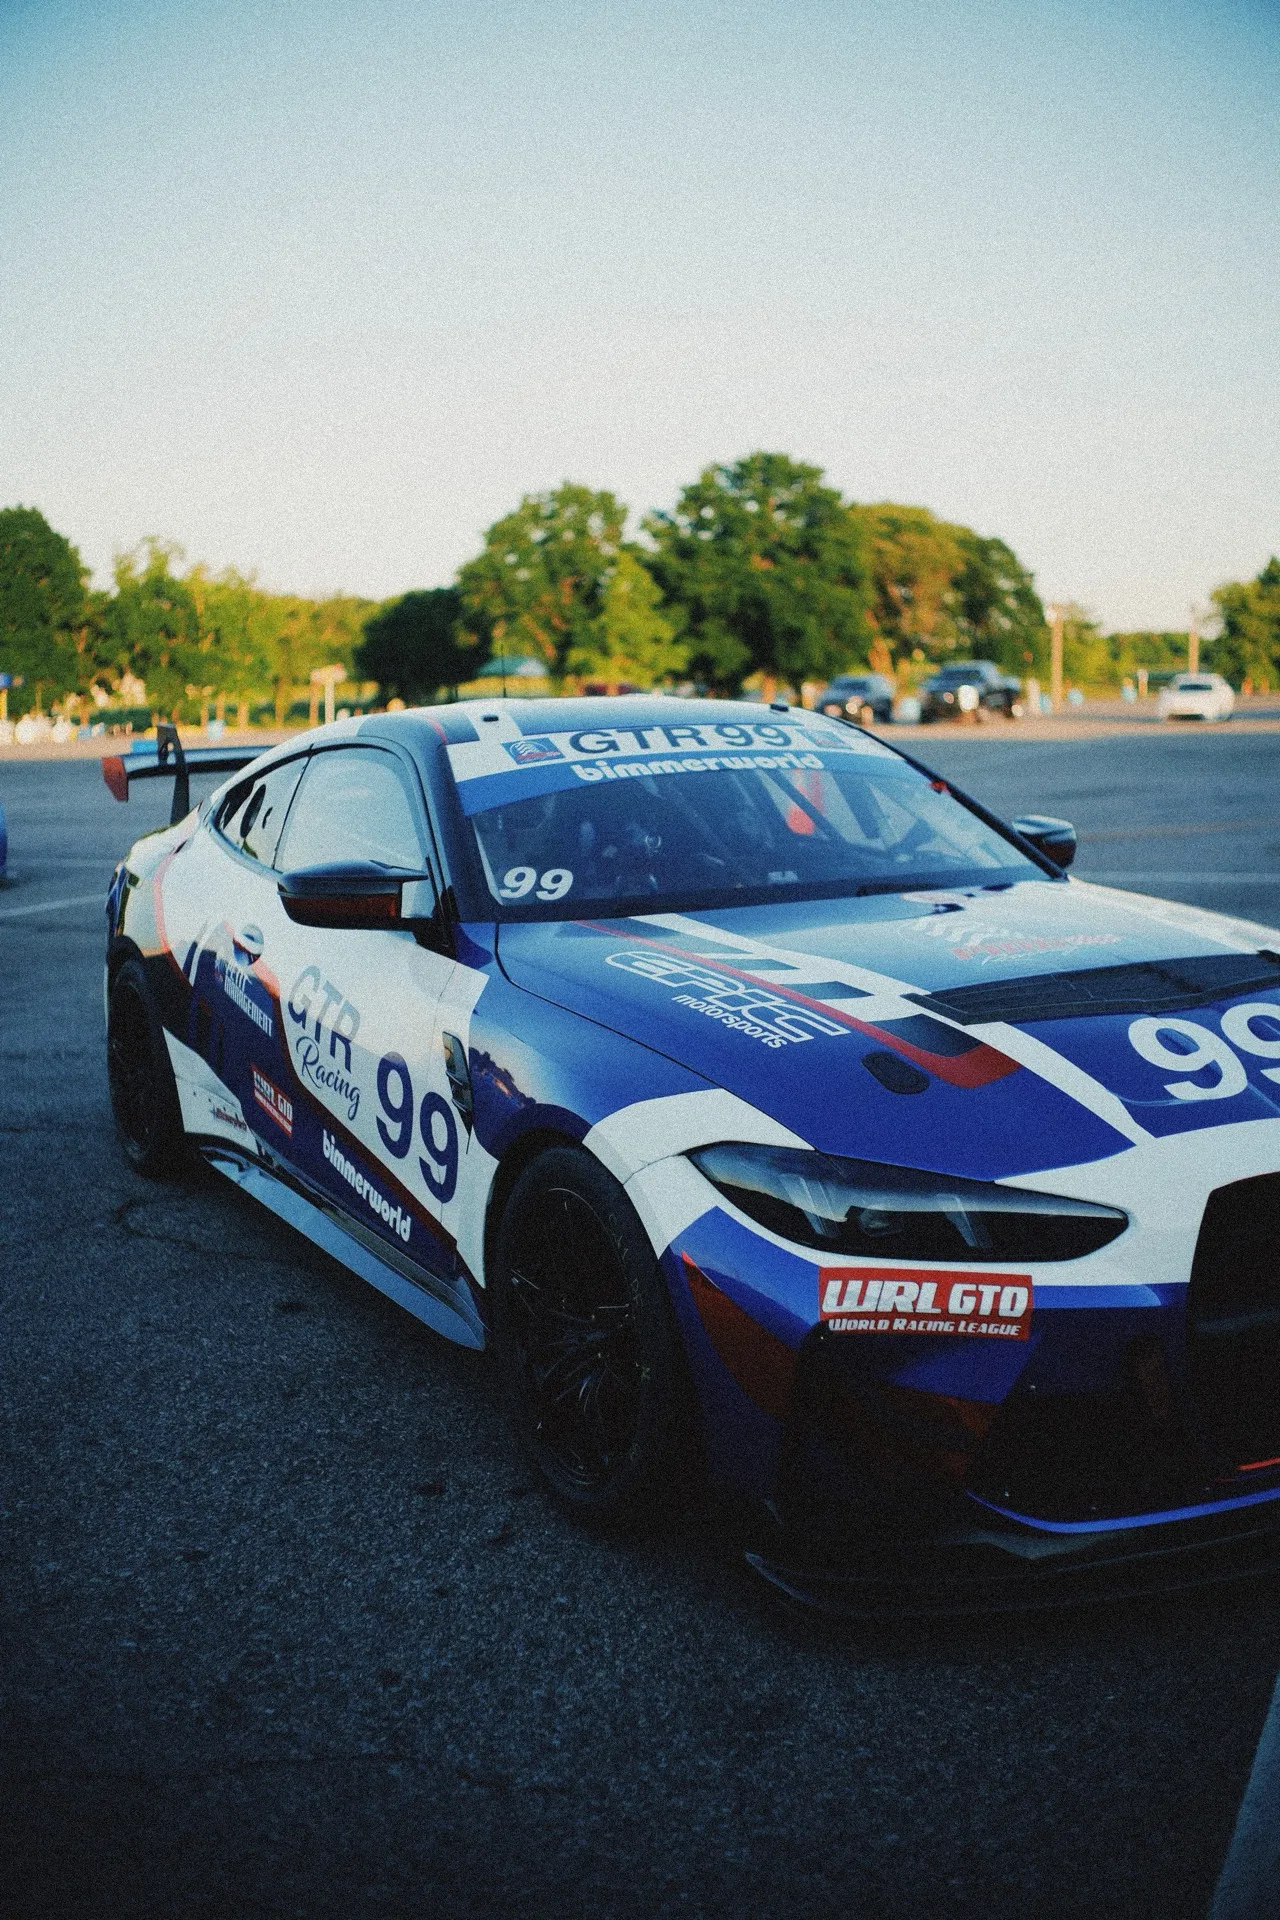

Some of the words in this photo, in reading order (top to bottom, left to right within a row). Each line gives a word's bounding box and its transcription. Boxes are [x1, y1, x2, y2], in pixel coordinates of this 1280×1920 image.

[569, 724, 708, 754] GTR
[714, 724, 792, 747] 99
[570, 753, 825, 781] bimmerworld
[499, 866, 574, 900] 99
[288, 965, 361, 1074] GTR
[671, 994, 788, 1049] motorsports
[295, 1036, 361, 1121] Racing
[376, 1051, 459, 1203] 99
[322, 1128, 412, 1242] bimmerworld
[822, 1280, 942, 1314] WRL
